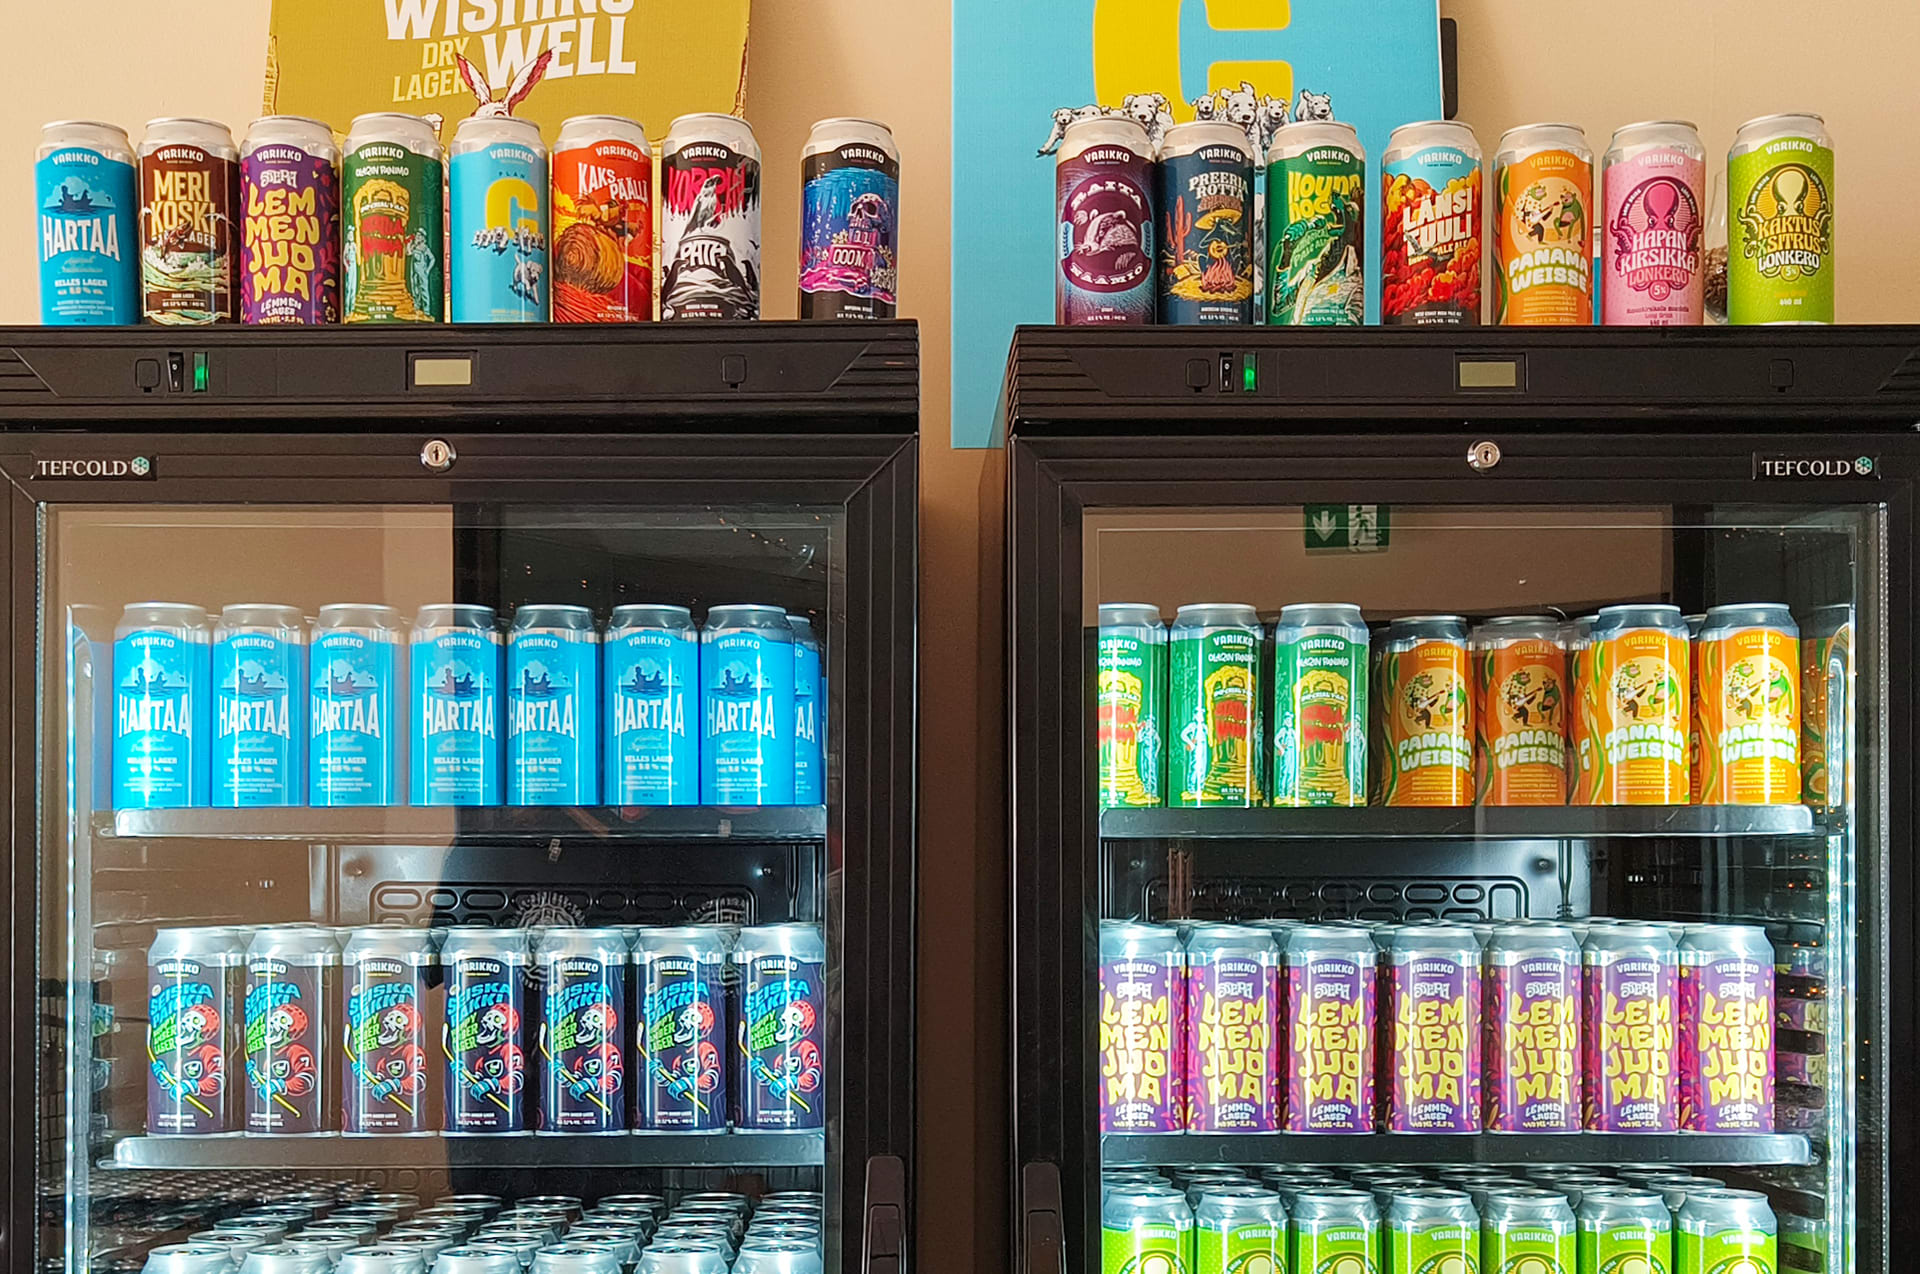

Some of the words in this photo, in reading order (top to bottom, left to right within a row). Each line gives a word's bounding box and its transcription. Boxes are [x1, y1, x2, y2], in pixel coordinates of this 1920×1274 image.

[422, 37, 470, 69] DRY
[482, 17, 637, 91] WELL
[52, 152, 99, 166] VARIKKO
[157, 148, 204, 162] VARIKKO
[256, 148, 302, 162] VARIKKO
[358, 146, 404, 160] VARIKKO
[489, 148, 534, 164] VARIKKO
[595, 146, 639, 161] VARIKKO
[681, 146, 728, 160] VARIKKO
[841, 148, 885, 164] VARIKKO
[1084, 150, 1130, 163] VARIKKO
[1199, 148, 1242, 162] VARIKKO
[1306, 150, 1350, 163] VARIKKO
[1417, 152, 1462, 165] VARIKKO
[1637, 153, 1685, 166] VARIKKO
[1765, 140, 1813, 155] VARIKKO
[499, 171, 526, 179] PLAN
[1529, 155, 1575, 168] VARIKKO
[153, 169, 210, 202] MERI
[578, 161, 616, 199] KAKS
[1189, 171, 1249, 195] PREERIA
[1195, 183, 1244, 203] ROTTA
[248, 182, 316, 217] LEM
[1403, 187, 1472, 232] LÄNSI
[150, 200, 216, 236] KOSKI
[245, 215, 320, 248] MEN
[1758, 215, 1821, 241] KAKTUS
[42, 214, 120, 262] HARTAA
[1403, 213, 1472, 257] TUULI
[1632, 230, 1687, 252] HAPAN
[248, 239, 315, 273] JUO
[679, 241, 728, 269] PATA
[1509, 248, 1588, 278] PANAMA
[1620, 248, 1695, 276] KIRSIKKA
[1758, 250, 1820, 273] LONKERO
[253, 265, 310, 302] MA
[1511, 267, 1588, 294] WEISSE
[1629, 267, 1688, 286] LONKERO
[38, 460, 128, 477] TEFCOLD
[1762, 460, 1850, 477] TEFCOLD
[231, 637, 275, 650] VARIKKO
[322, 636, 363, 649] VARIKKO
[436, 637, 481, 649] VARIKKO
[518, 637, 558, 649] VARIKKO
[627, 636, 671, 648] VARIKKO
[718, 638, 760, 650] VARIKKO
[1213, 634, 1254, 648] VARIKKO
[1300, 638, 1345, 650] VARIKKO
[1417, 647, 1458, 658] VARIKKO
[1623, 635, 1667, 647] VARIKKO
[1736, 635, 1781, 646] VARIKO
[119, 693, 192, 739] HARTAA
[219, 694, 291, 740] HARTAA
[313, 693, 380, 739] HARTAA
[422, 693, 495, 740] HARTAA
[508, 693, 575, 740] HARTAA
[614, 692, 685, 738] HARTAA
[706, 695, 776, 739] HARTAA
[1398, 732, 1472, 757] PANAMA
[1494, 729, 1565, 753] PANAMA
[1604, 724, 1684, 749] PANAMA
[1718, 724, 1797, 748] PANAMA
[1401, 750, 1470, 772] WEISSE
[1498, 747, 1565, 770] WEISSE
[1608, 743, 1683, 765] WEISSE
[1722, 742, 1796, 765] WEISSE
[157, 963, 200, 974] VARKKO
[754, 960, 798, 972] VARIKO
[1311, 963, 1355, 974] VARIKKO
[1616, 962, 1660, 973] VARIKKO
[1102, 991, 1168, 1026] LEM
[1202, 991, 1265, 1026] LEM
[1298, 992, 1364, 1026] LEM
[1398, 991, 1465, 1026] LEM
[1509, 991, 1575, 1025] LEM
[1605, 991, 1670, 1026] LEM
[1702, 991, 1768, 1026] LEM
[1100, 1022, 1168, 1050] MEN
[1198, 1023, 1270, 1051] MEN
[1294, 1023, 1367, 1051] MEN
[1395, 1023, 1468, 1051] MEN
[1505, 1022, 1577, 1050] MEN
[1601, 1022, 1673, 1050] MEN
[1697, 1022, 1770, 1051] MEN
[1102, 1046, 1167, 1077] JUO
[1202, 1048, 1265, 1077] JUO
[1298, 1048, 1361, 1077] JUO
[1399, 1048, 1463, 1077] JUO
[1510, 1046, 1574, 1077] JUO
[1606, 1046, 1669, 1077] JUO
[1702, 1047, 1768, 1078] JUO
[1108, 1072, 1162, 1105] MA
[1208, 1072, 1262, 1105] MA
[1304, 1073, 1358, 1106] MA
[1404, 1073, 1460, 1106] MA
[1515, 1073, 1570, 1106] MA
[1611, 1073, 1667, 1106] MA
[1709, 1073, 1764, 1106] MA
[1326, 1231, 1367, 1242] VARIKKO
[1510, 1232, 1554, 1243] VARIKKO
